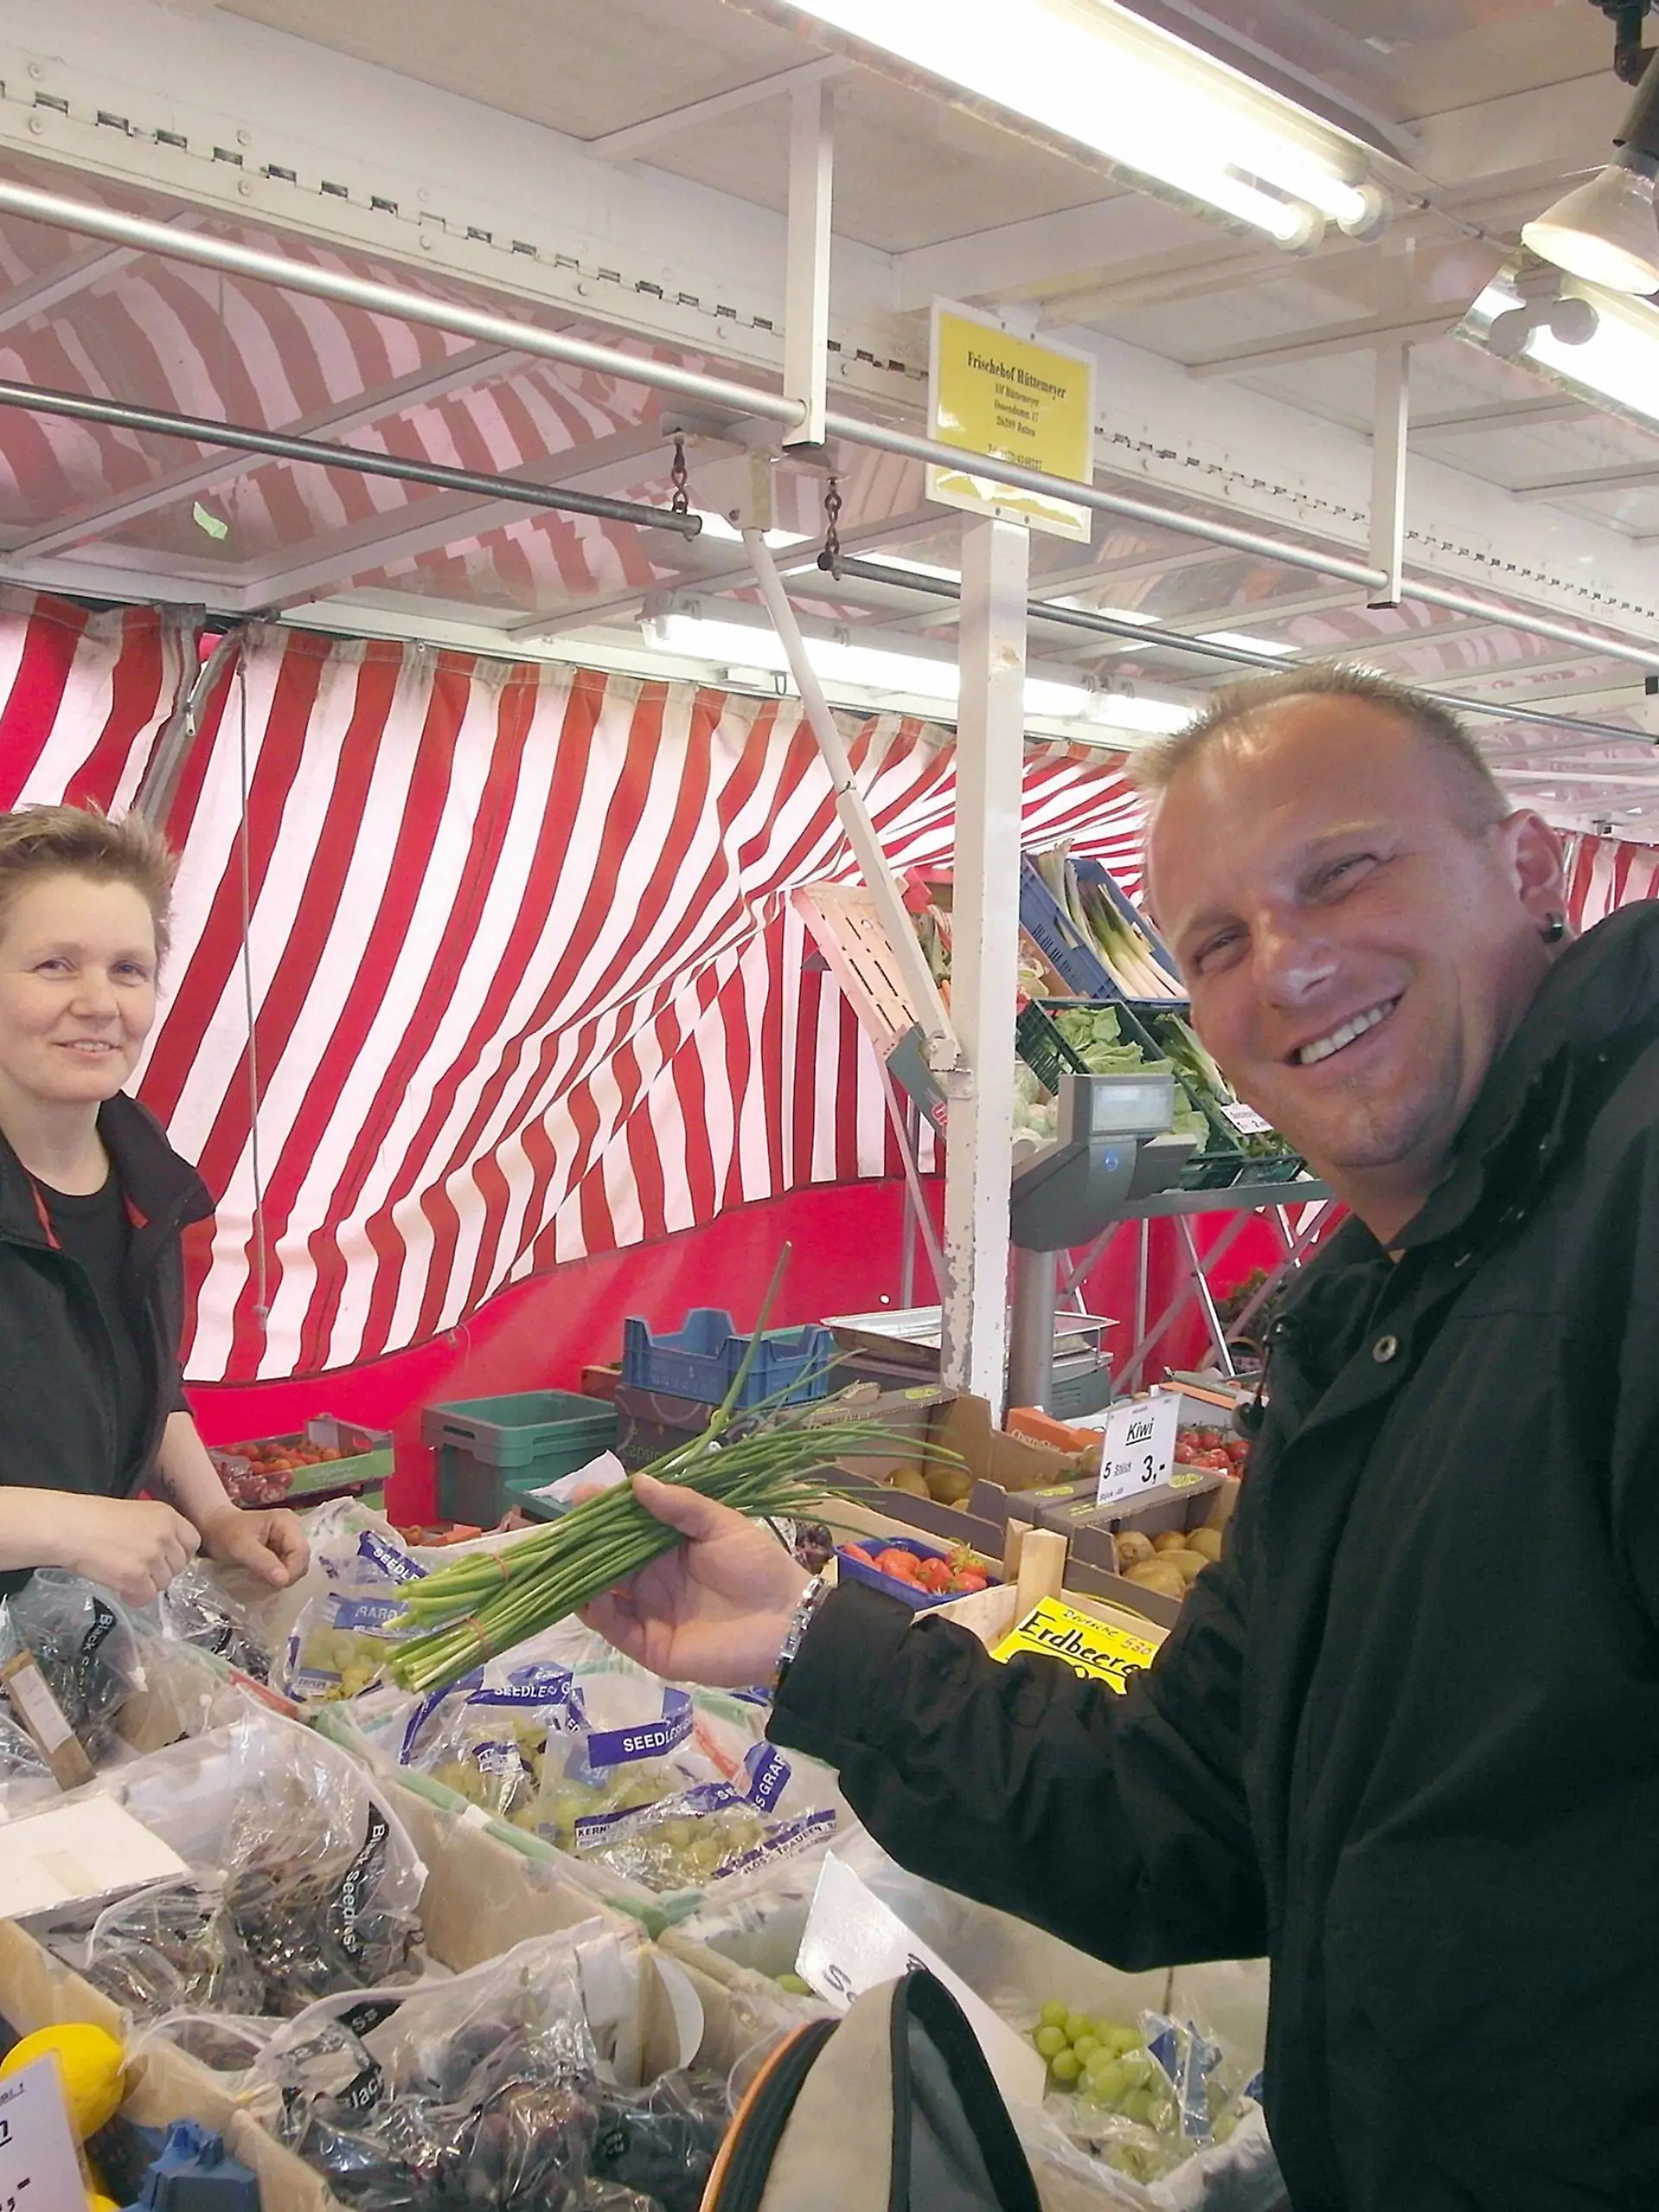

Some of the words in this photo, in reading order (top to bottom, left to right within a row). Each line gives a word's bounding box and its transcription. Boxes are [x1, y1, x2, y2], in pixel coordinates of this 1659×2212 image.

[968, 351, 1015, 381] Frischehof
[1127, 1417, 1155, 1442] Kiwi
[1103, 1461, 1112, 1479] 5
